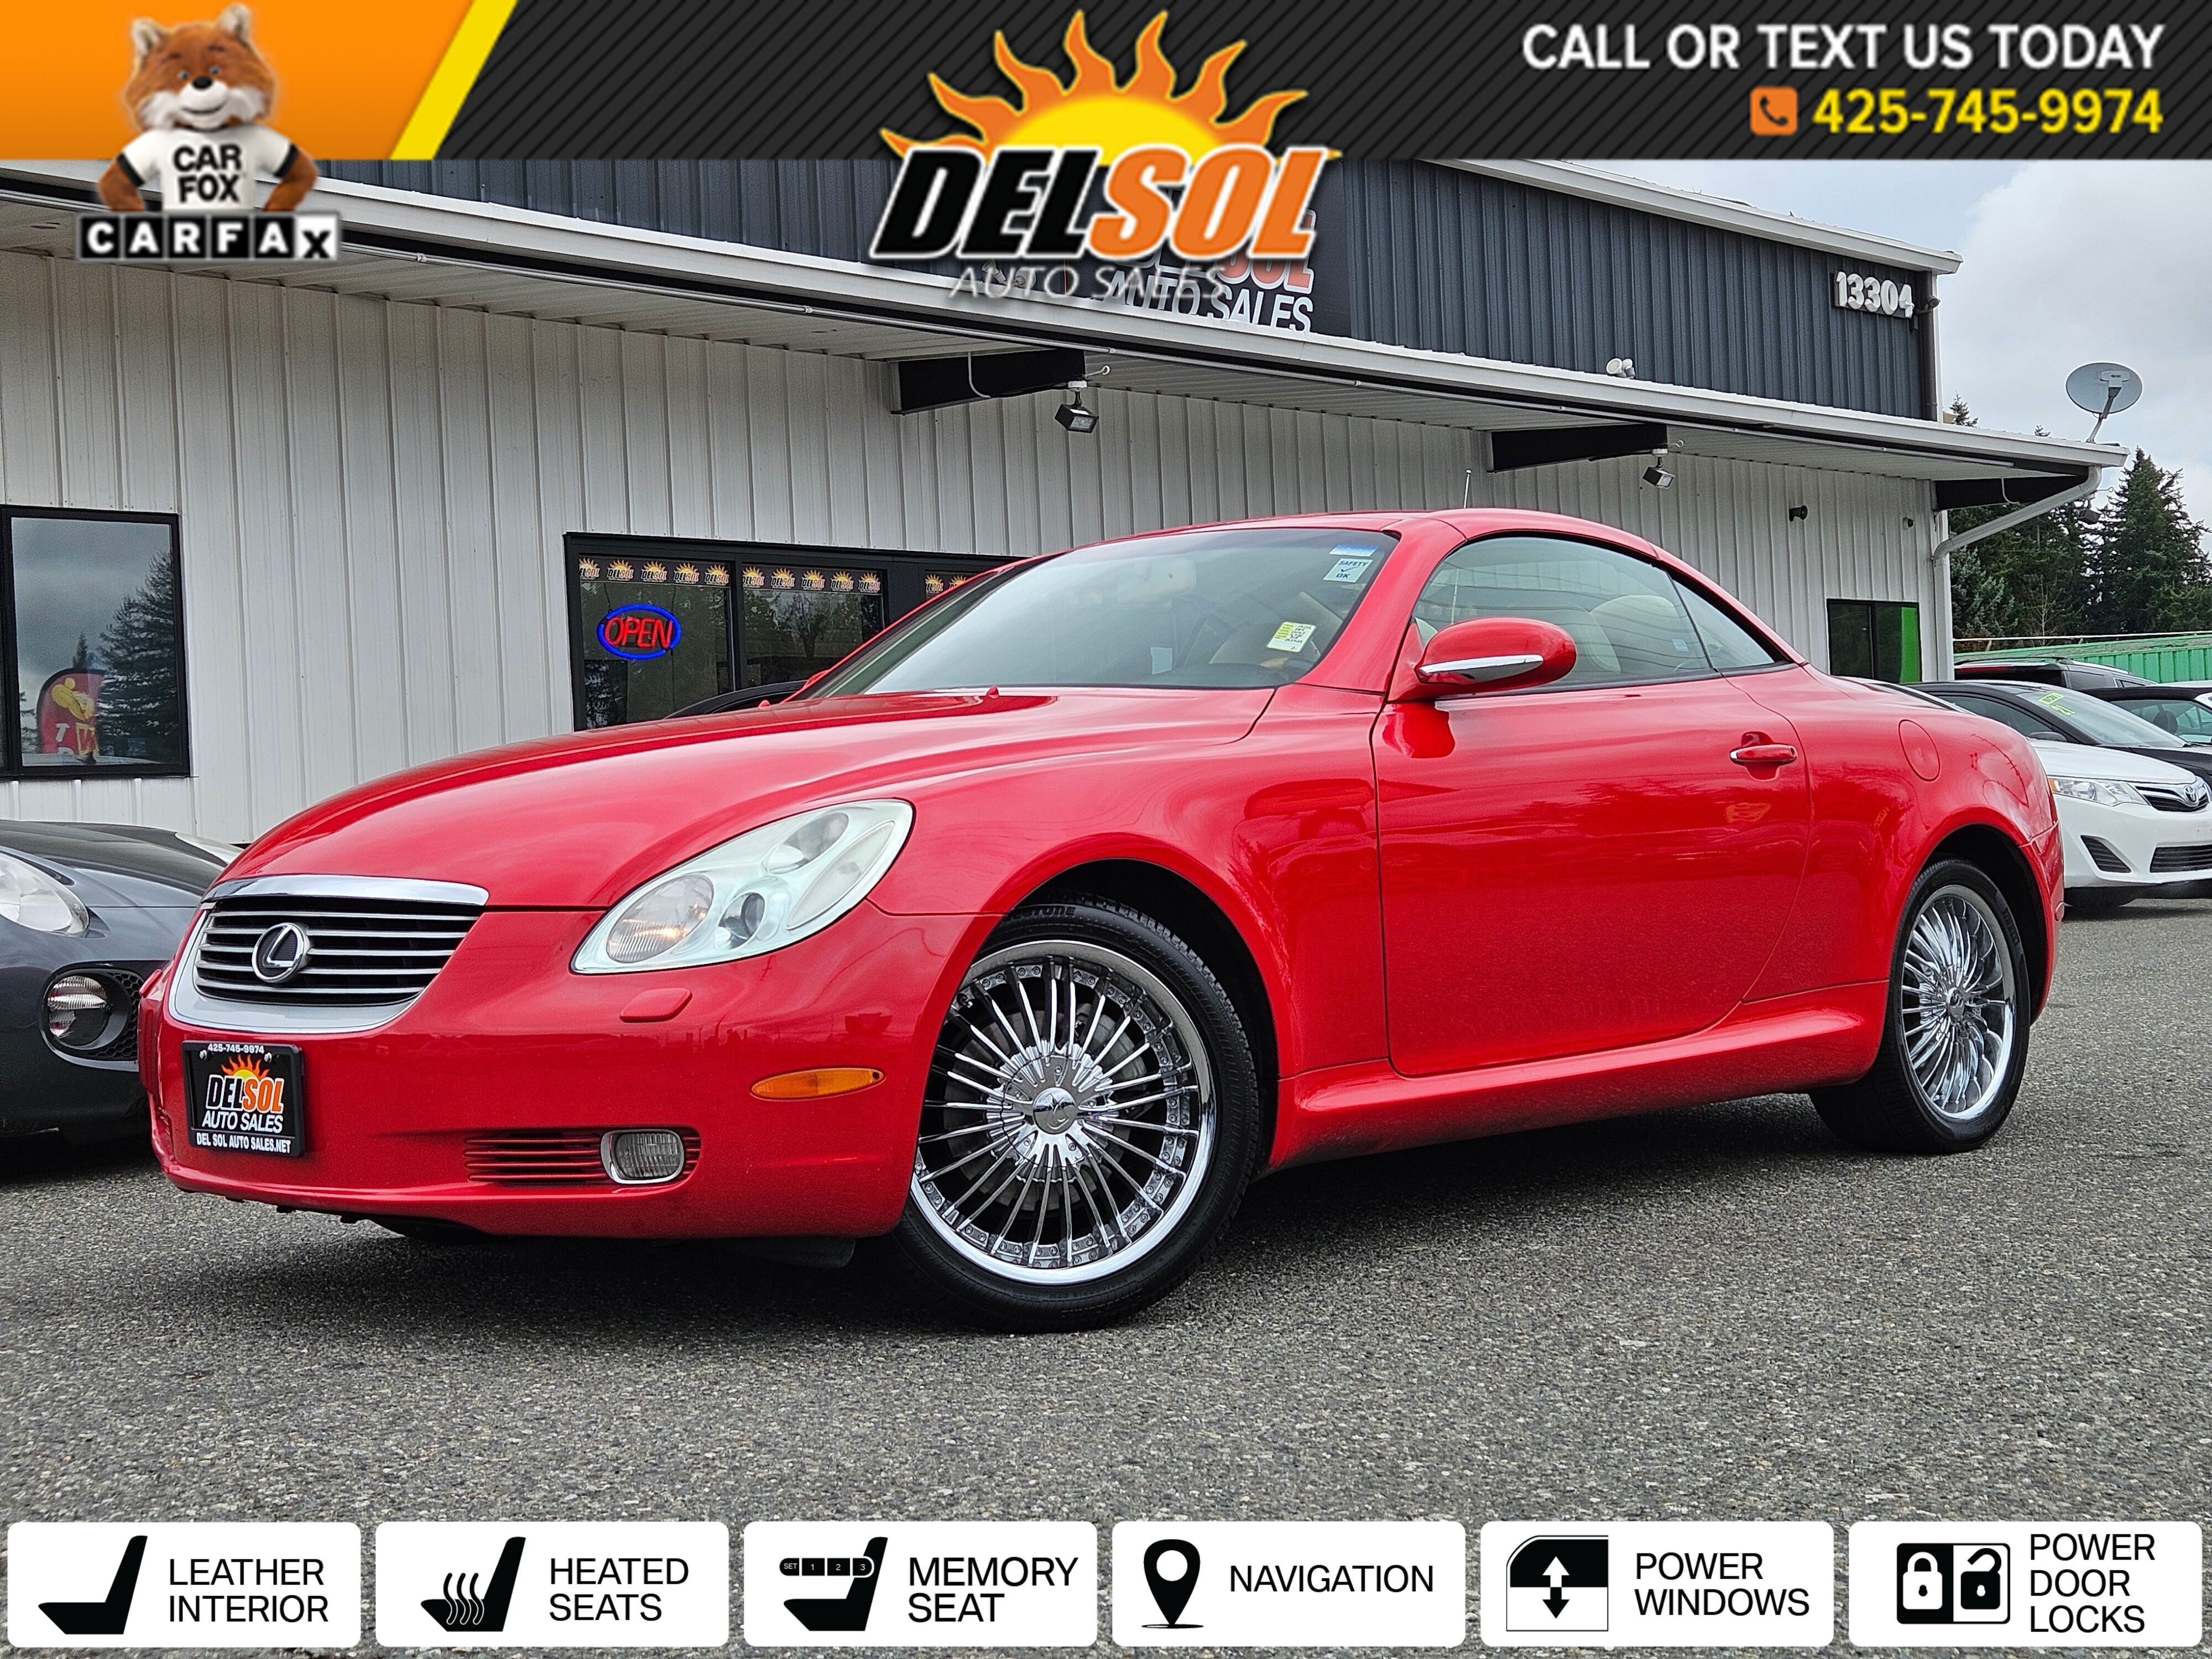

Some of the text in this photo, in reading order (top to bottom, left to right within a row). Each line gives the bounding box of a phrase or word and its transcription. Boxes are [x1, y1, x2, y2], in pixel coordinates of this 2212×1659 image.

[1209, 284, 1313, 332] SALES
[1836, 271, 1915, 318] 13304
[604, 616, 674, 649] OPEN
[207, 1043, 264, 1055] 425-745-9974
[202, 1110, 284, 1133] AUTO SALES
[196, 1132, 291, 1154] DEL SOL AUTO SALES.NET
